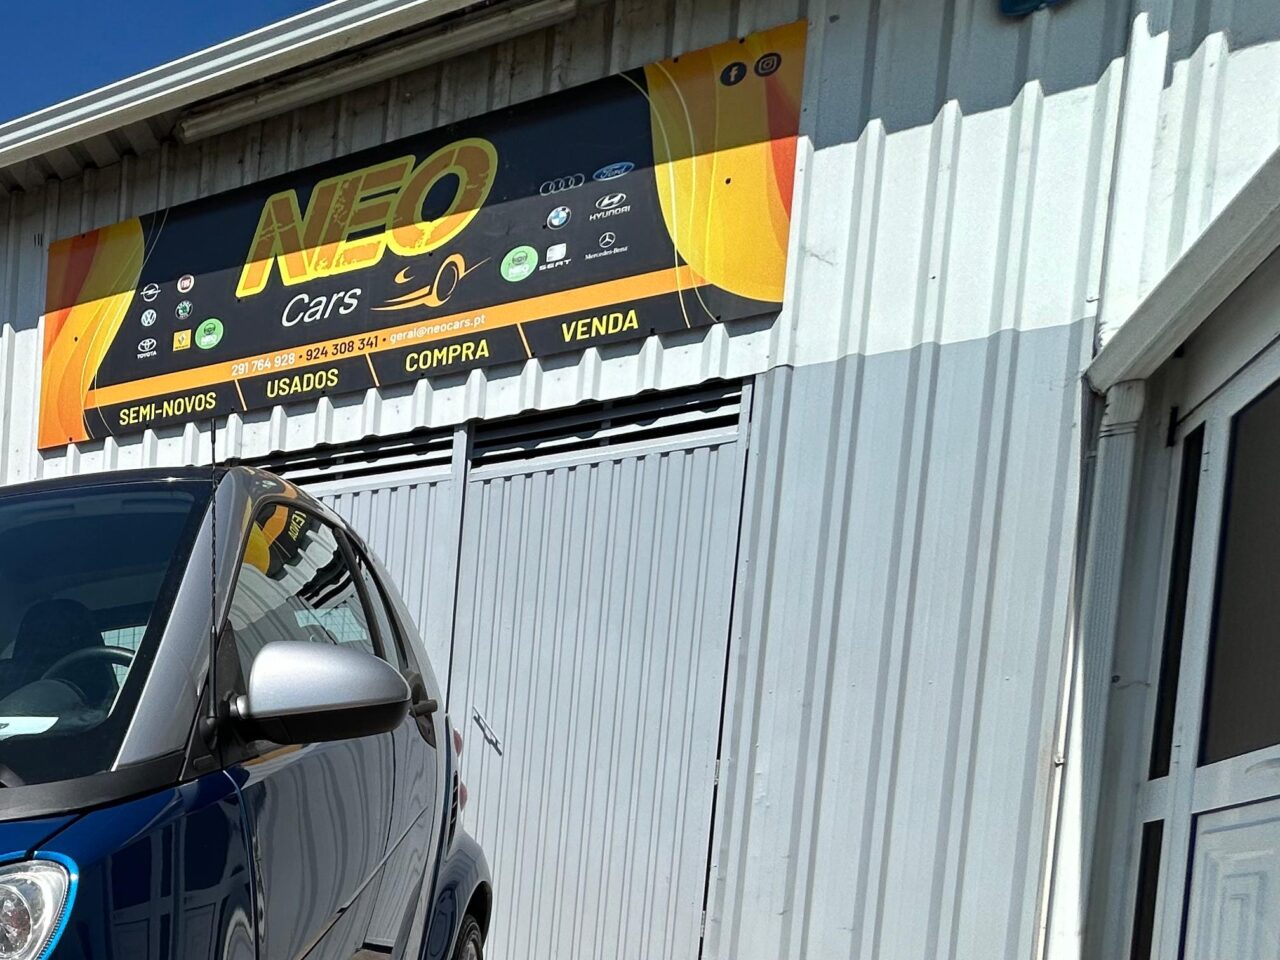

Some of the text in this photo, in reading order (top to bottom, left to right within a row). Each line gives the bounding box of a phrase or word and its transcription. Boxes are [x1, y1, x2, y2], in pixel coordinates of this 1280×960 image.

[235, 137, 499, 298] NEO
[589, 205, 631, 222] HYUNDAI
[539, 259, 572, 271] SEAT
[281, 287, 362, 327] Cars
[561, 309, 639, 342] VENDA
[231, 314, 486, 376] 291 764 928 924 308 341 geral@neocars.pt
[405, 339, 489, 372] COMPRA
[266, 368, 339, 398] USADOS
[119, 391, 217, 426] SEMI-NOVOS
